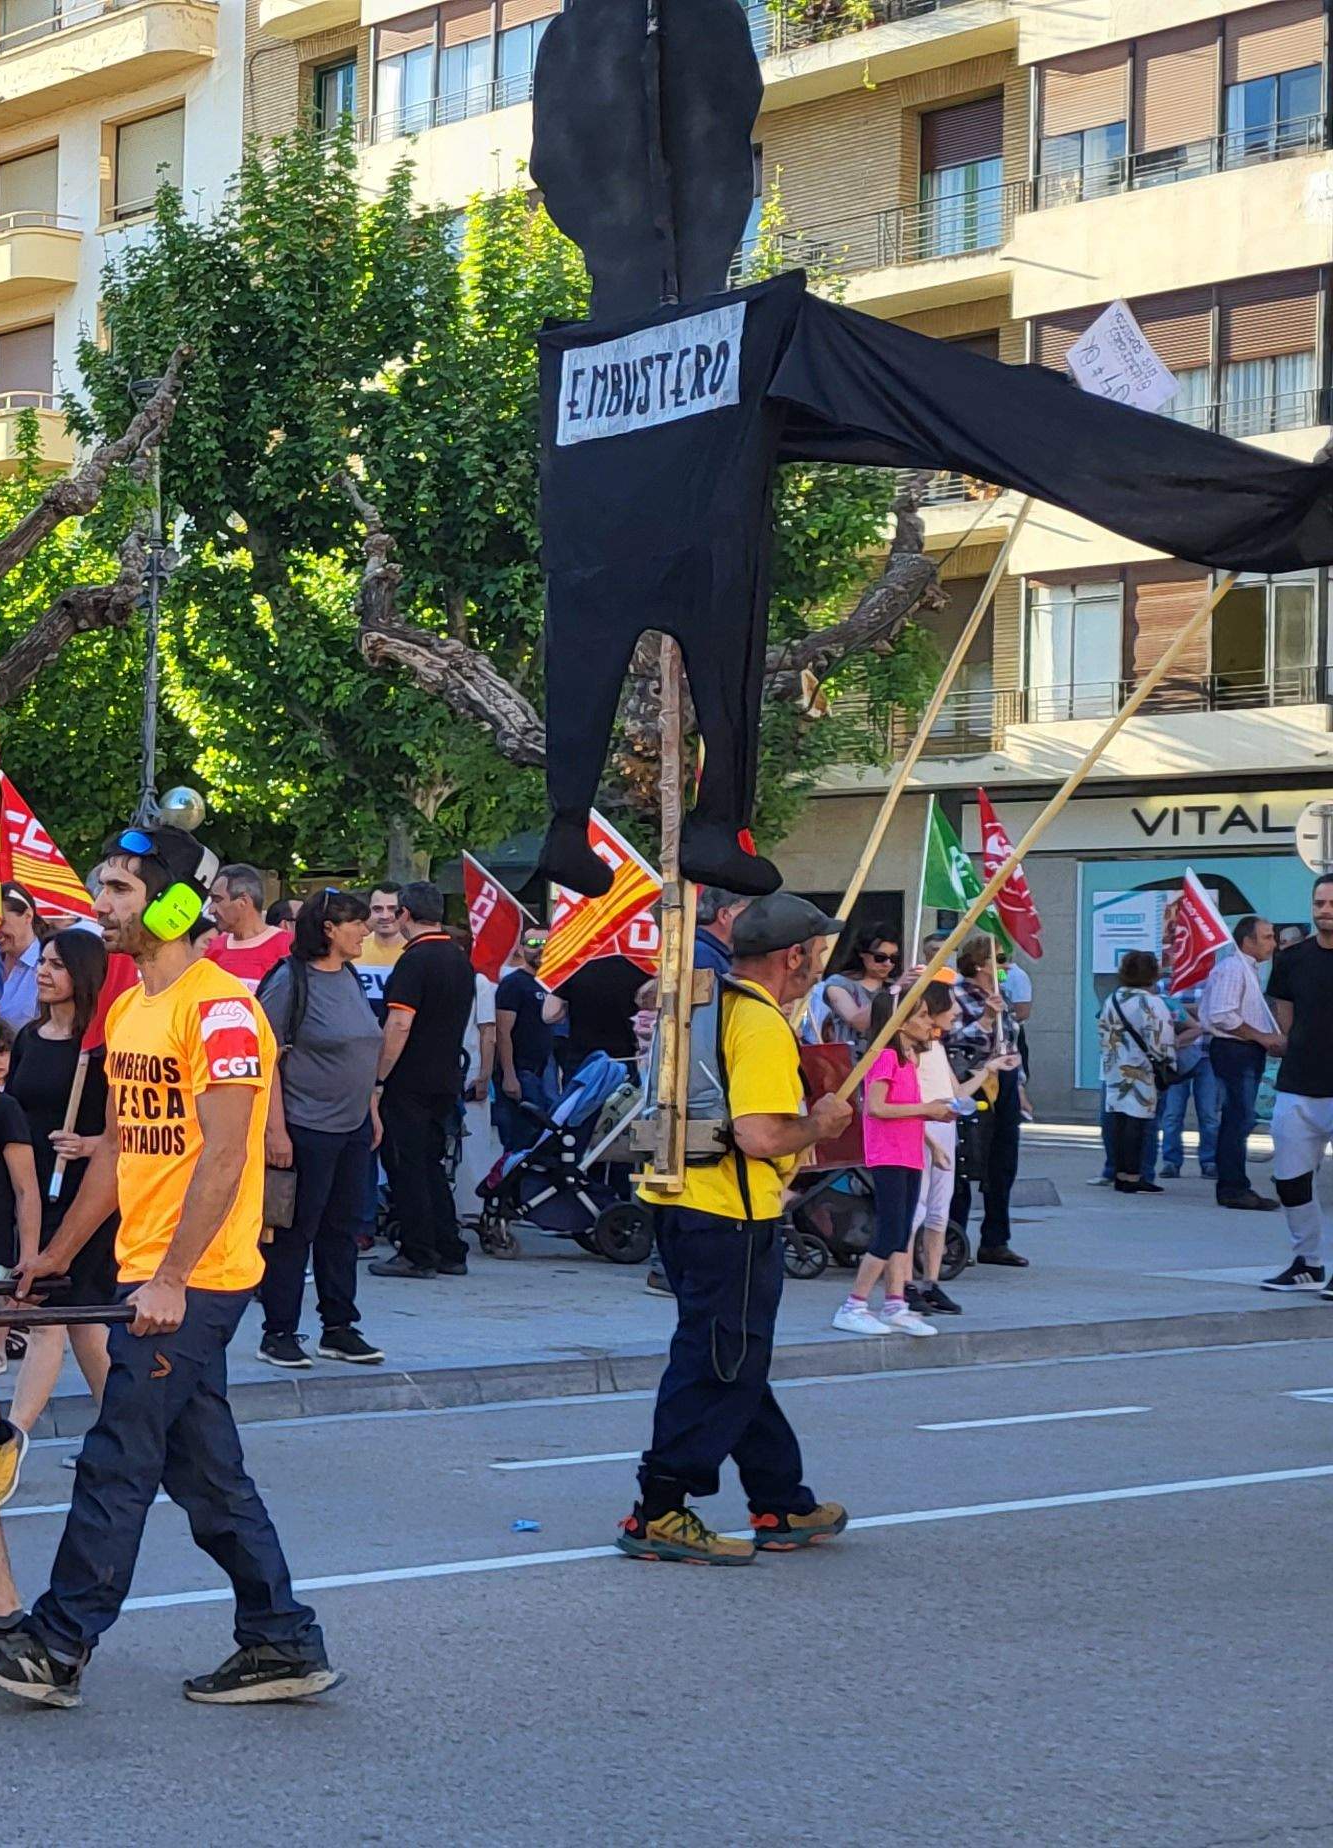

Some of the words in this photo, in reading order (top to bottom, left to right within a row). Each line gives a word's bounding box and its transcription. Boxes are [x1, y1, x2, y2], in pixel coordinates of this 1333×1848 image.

[566, 340, 731, 422] EMBUSTERO
[1131, 803, 1305, 837] VITAL
[212, 1056, 259, 1078] CGT
[113, 1084, 186, 1119] ESCA
[117, 1124, 186, 1156] ENTADOS
